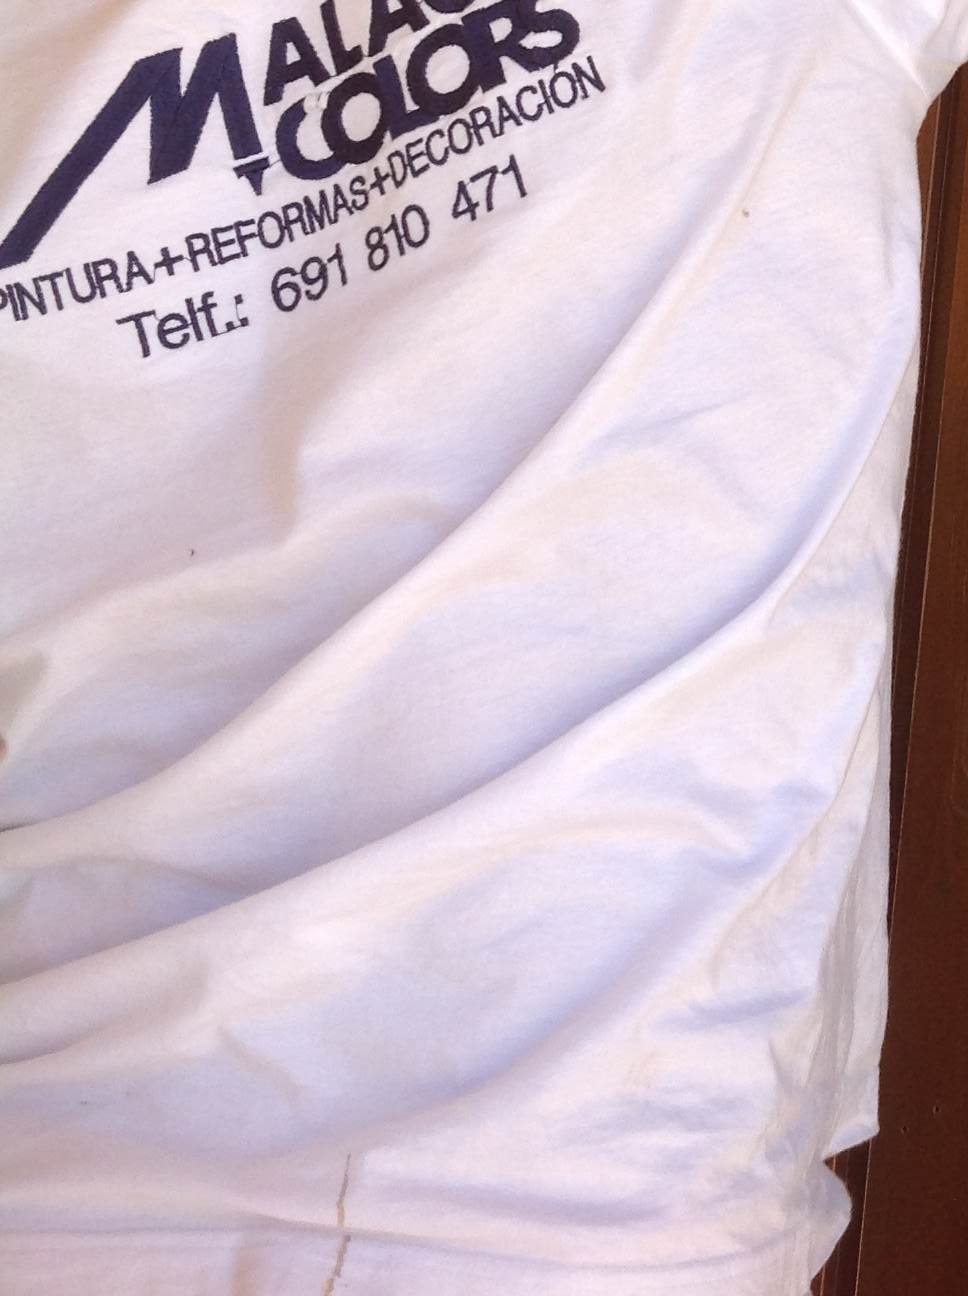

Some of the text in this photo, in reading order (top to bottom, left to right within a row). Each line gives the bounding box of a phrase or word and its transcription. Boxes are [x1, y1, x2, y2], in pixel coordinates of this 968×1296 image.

[117, 154, 528, 358] Telf.: 691 810 471
